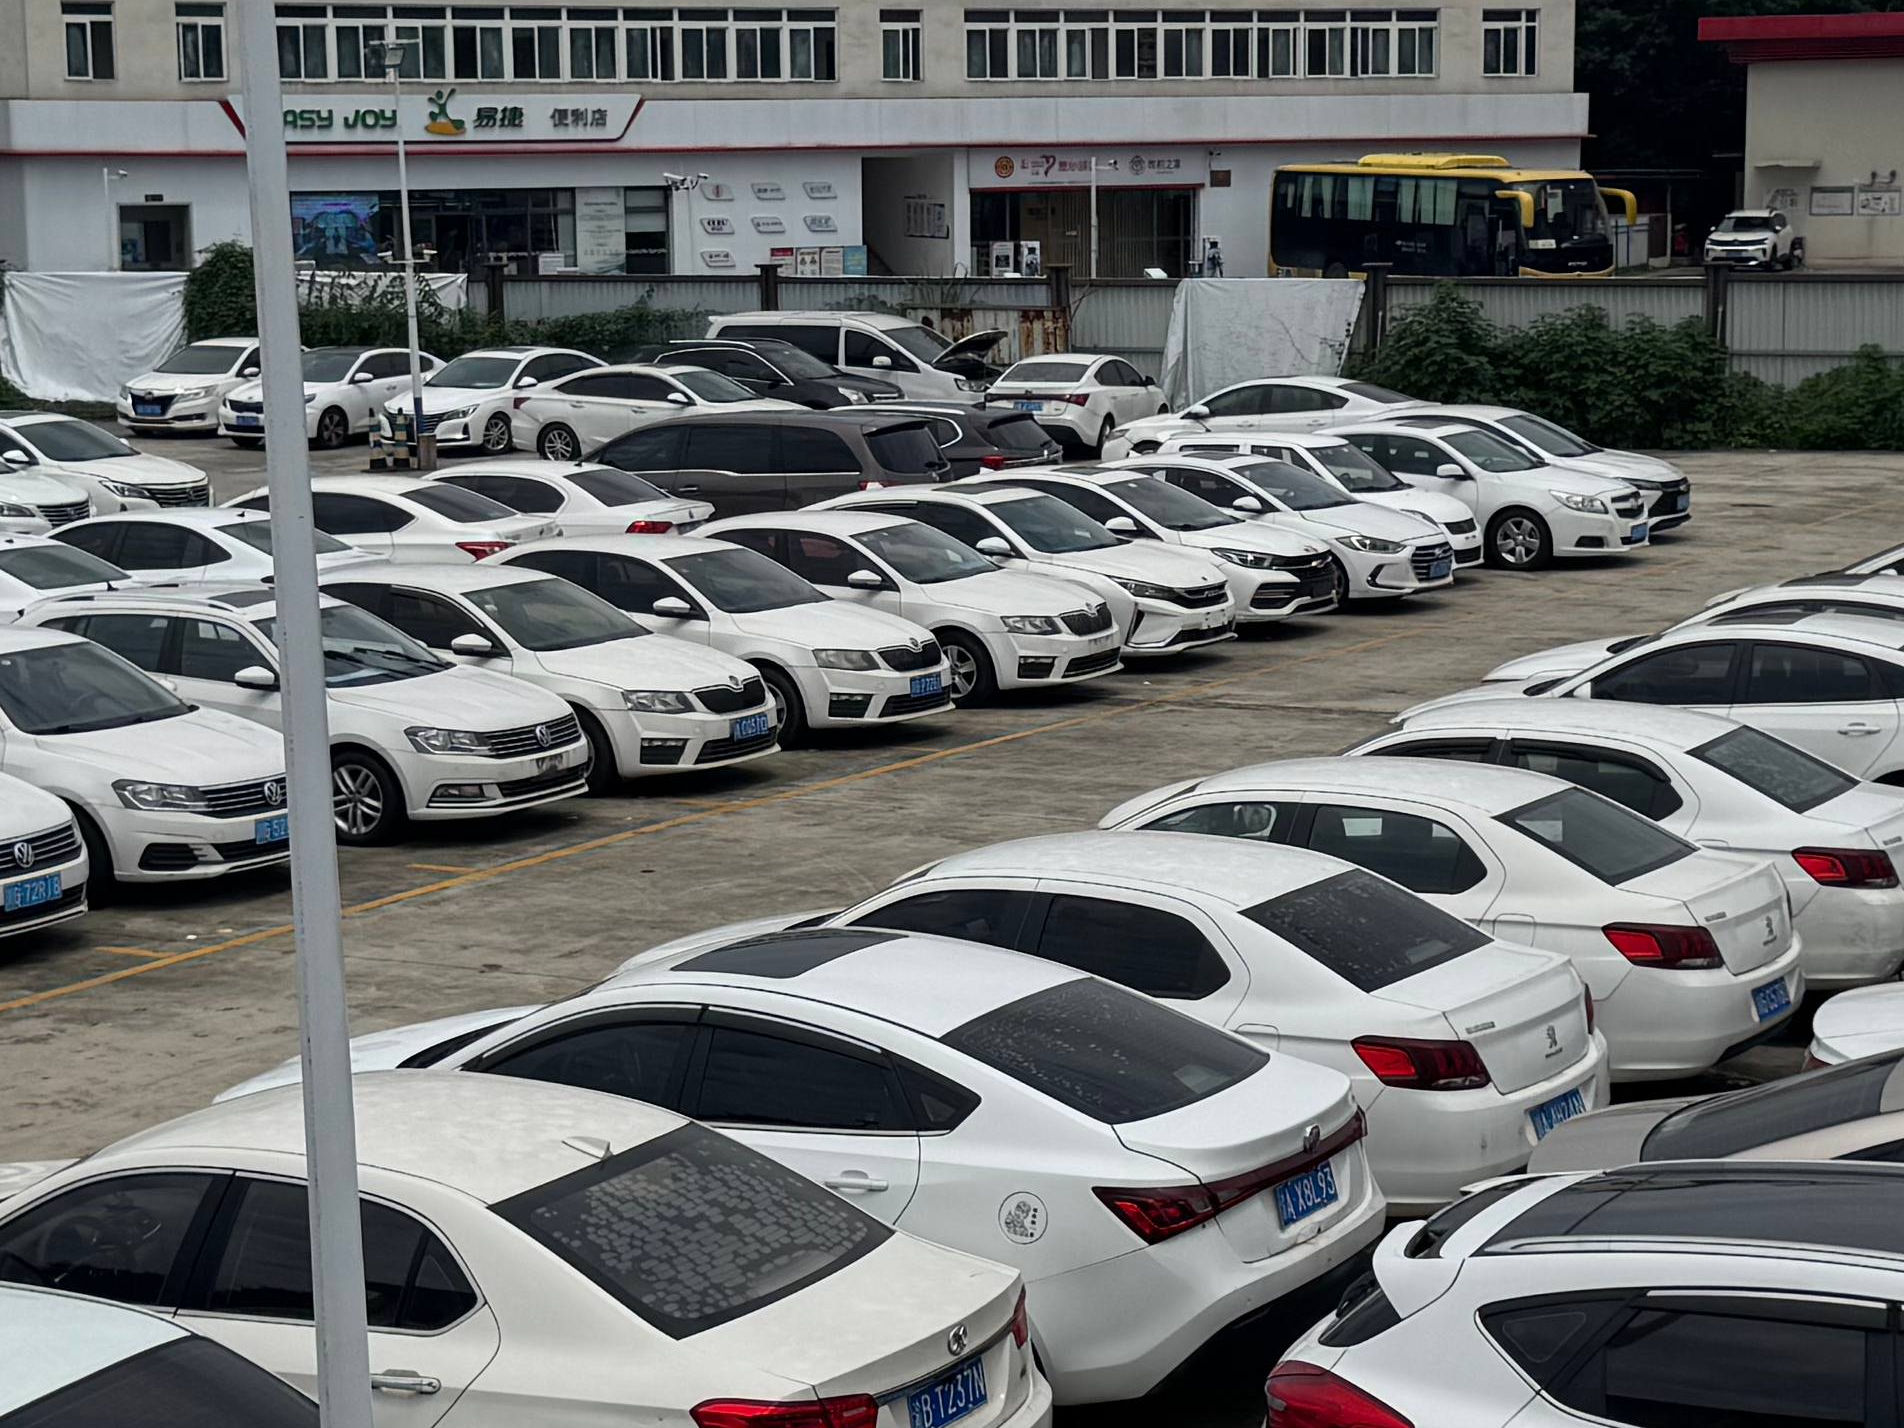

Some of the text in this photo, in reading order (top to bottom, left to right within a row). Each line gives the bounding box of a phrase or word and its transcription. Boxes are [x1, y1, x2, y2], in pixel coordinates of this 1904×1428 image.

[283, 105, 608, 130] ASY JOY 易捷 便利店
